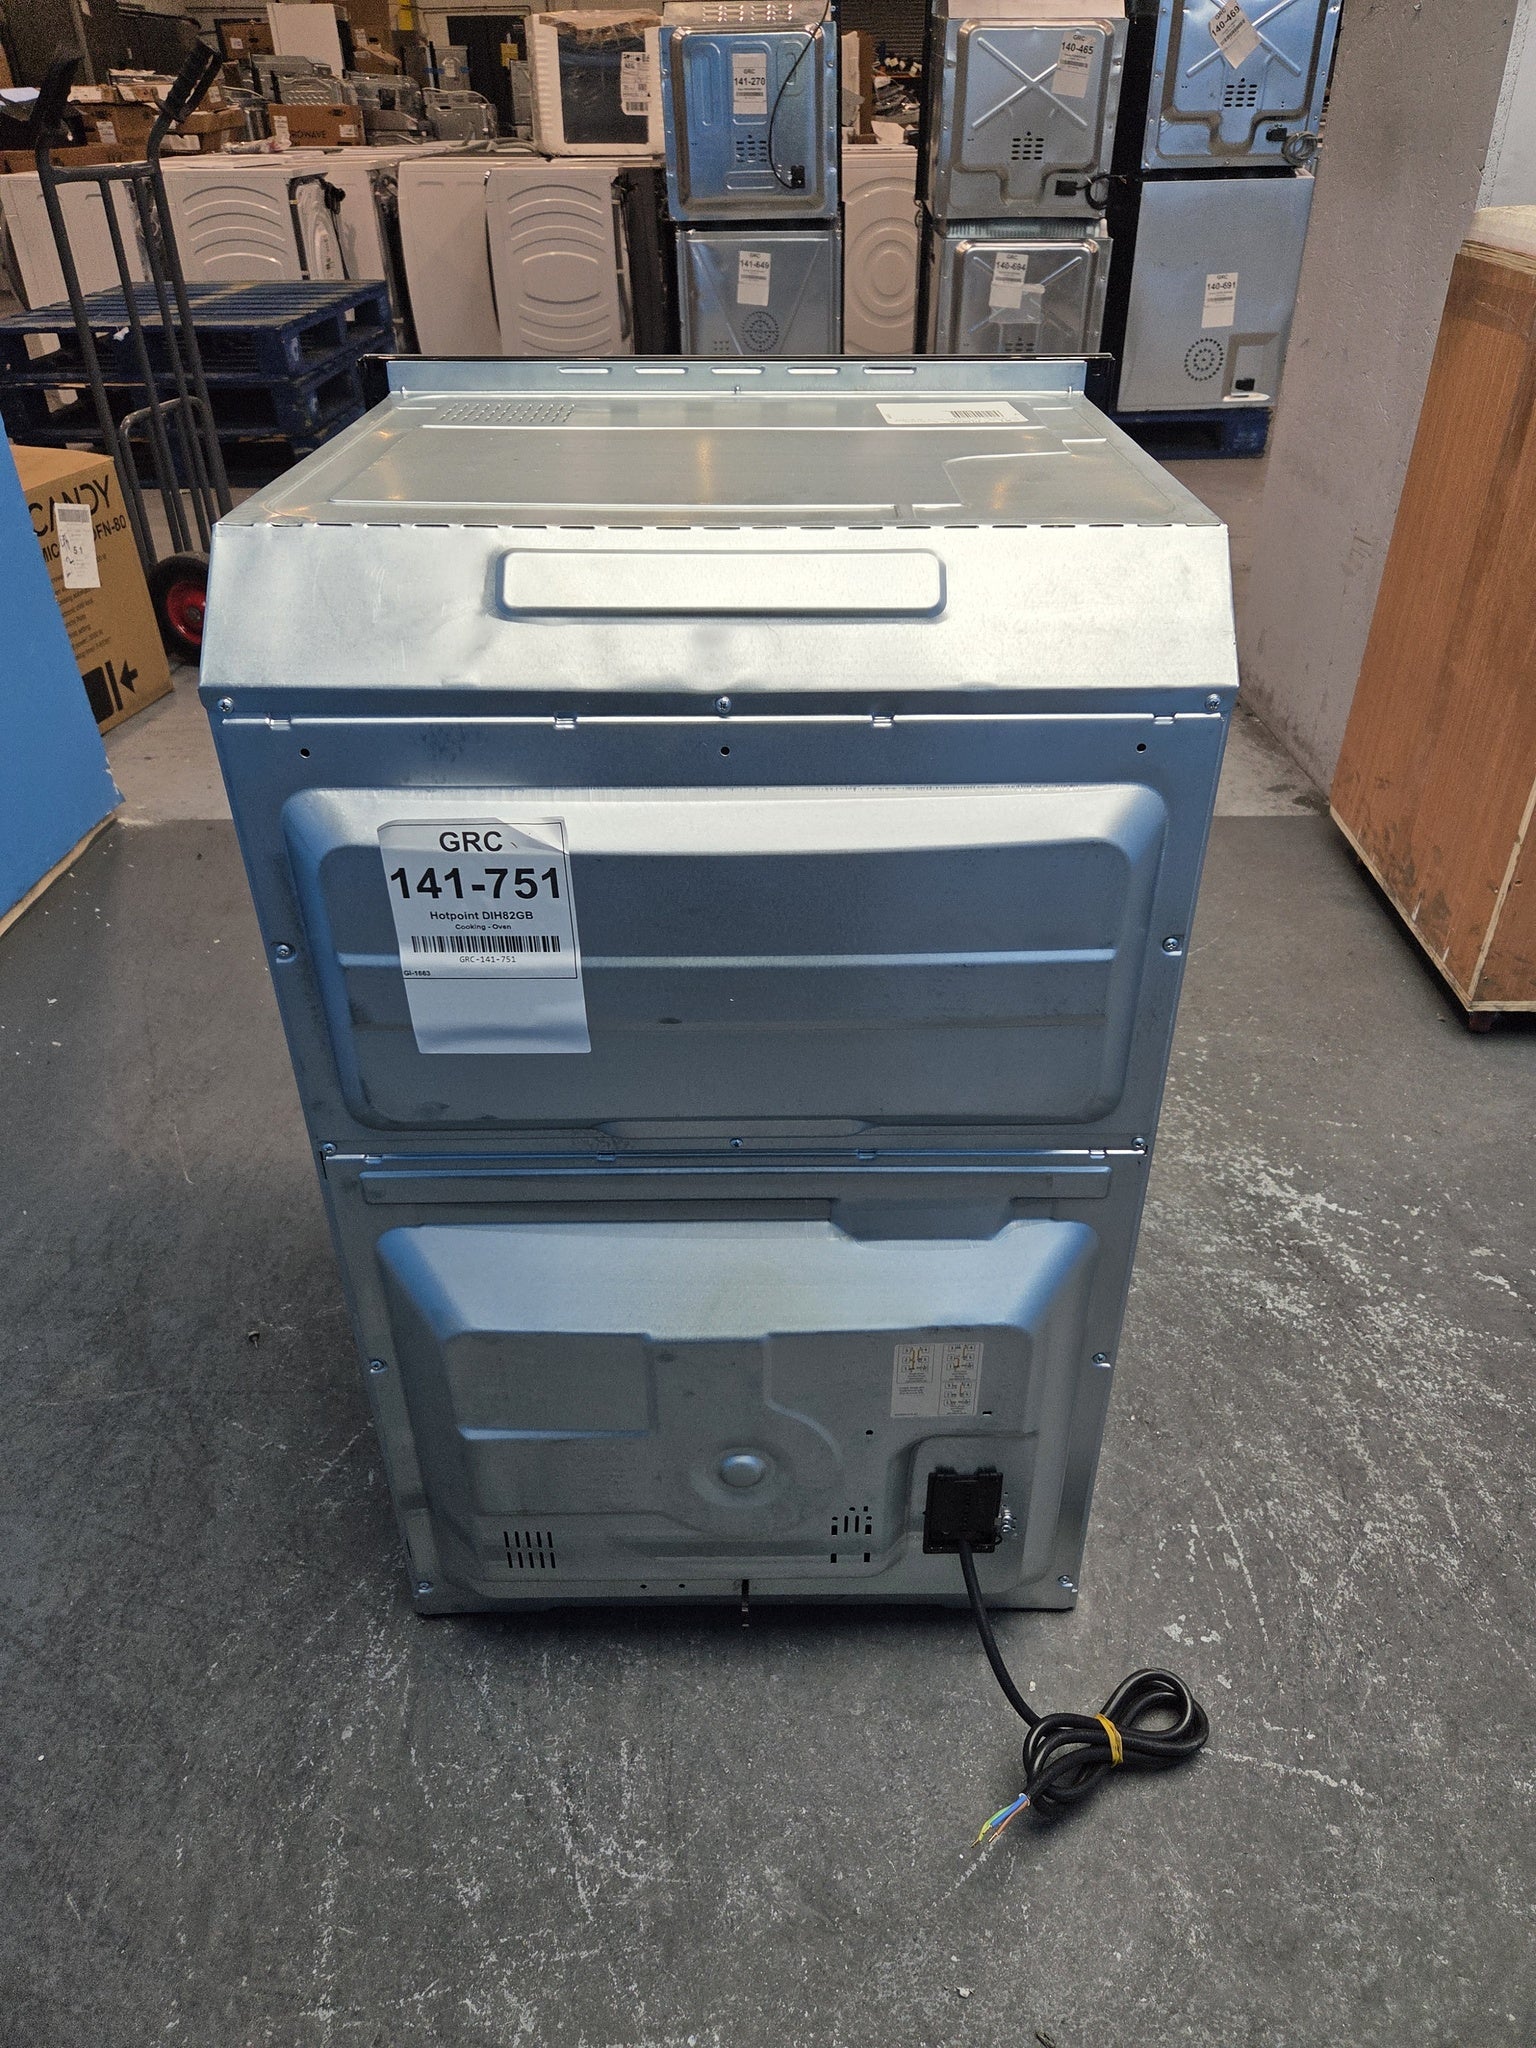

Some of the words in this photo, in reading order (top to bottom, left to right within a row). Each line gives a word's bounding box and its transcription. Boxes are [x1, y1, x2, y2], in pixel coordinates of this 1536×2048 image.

[1212, 6, 1240, 36] 140-469
[1062, 42, 1094, 54] 140-465
[734, 77, 766, 86] 141-270
[439, 831, 503, 852] GRC
[390, 867, 560, 899] 141-751
[430, 911, 479, 921] Hotpoint
[482, 911, 534, 920] DIH82GB
[455, 923, 486, 931] Cooking
[459, 955, 516, 963] GRC-141-751
